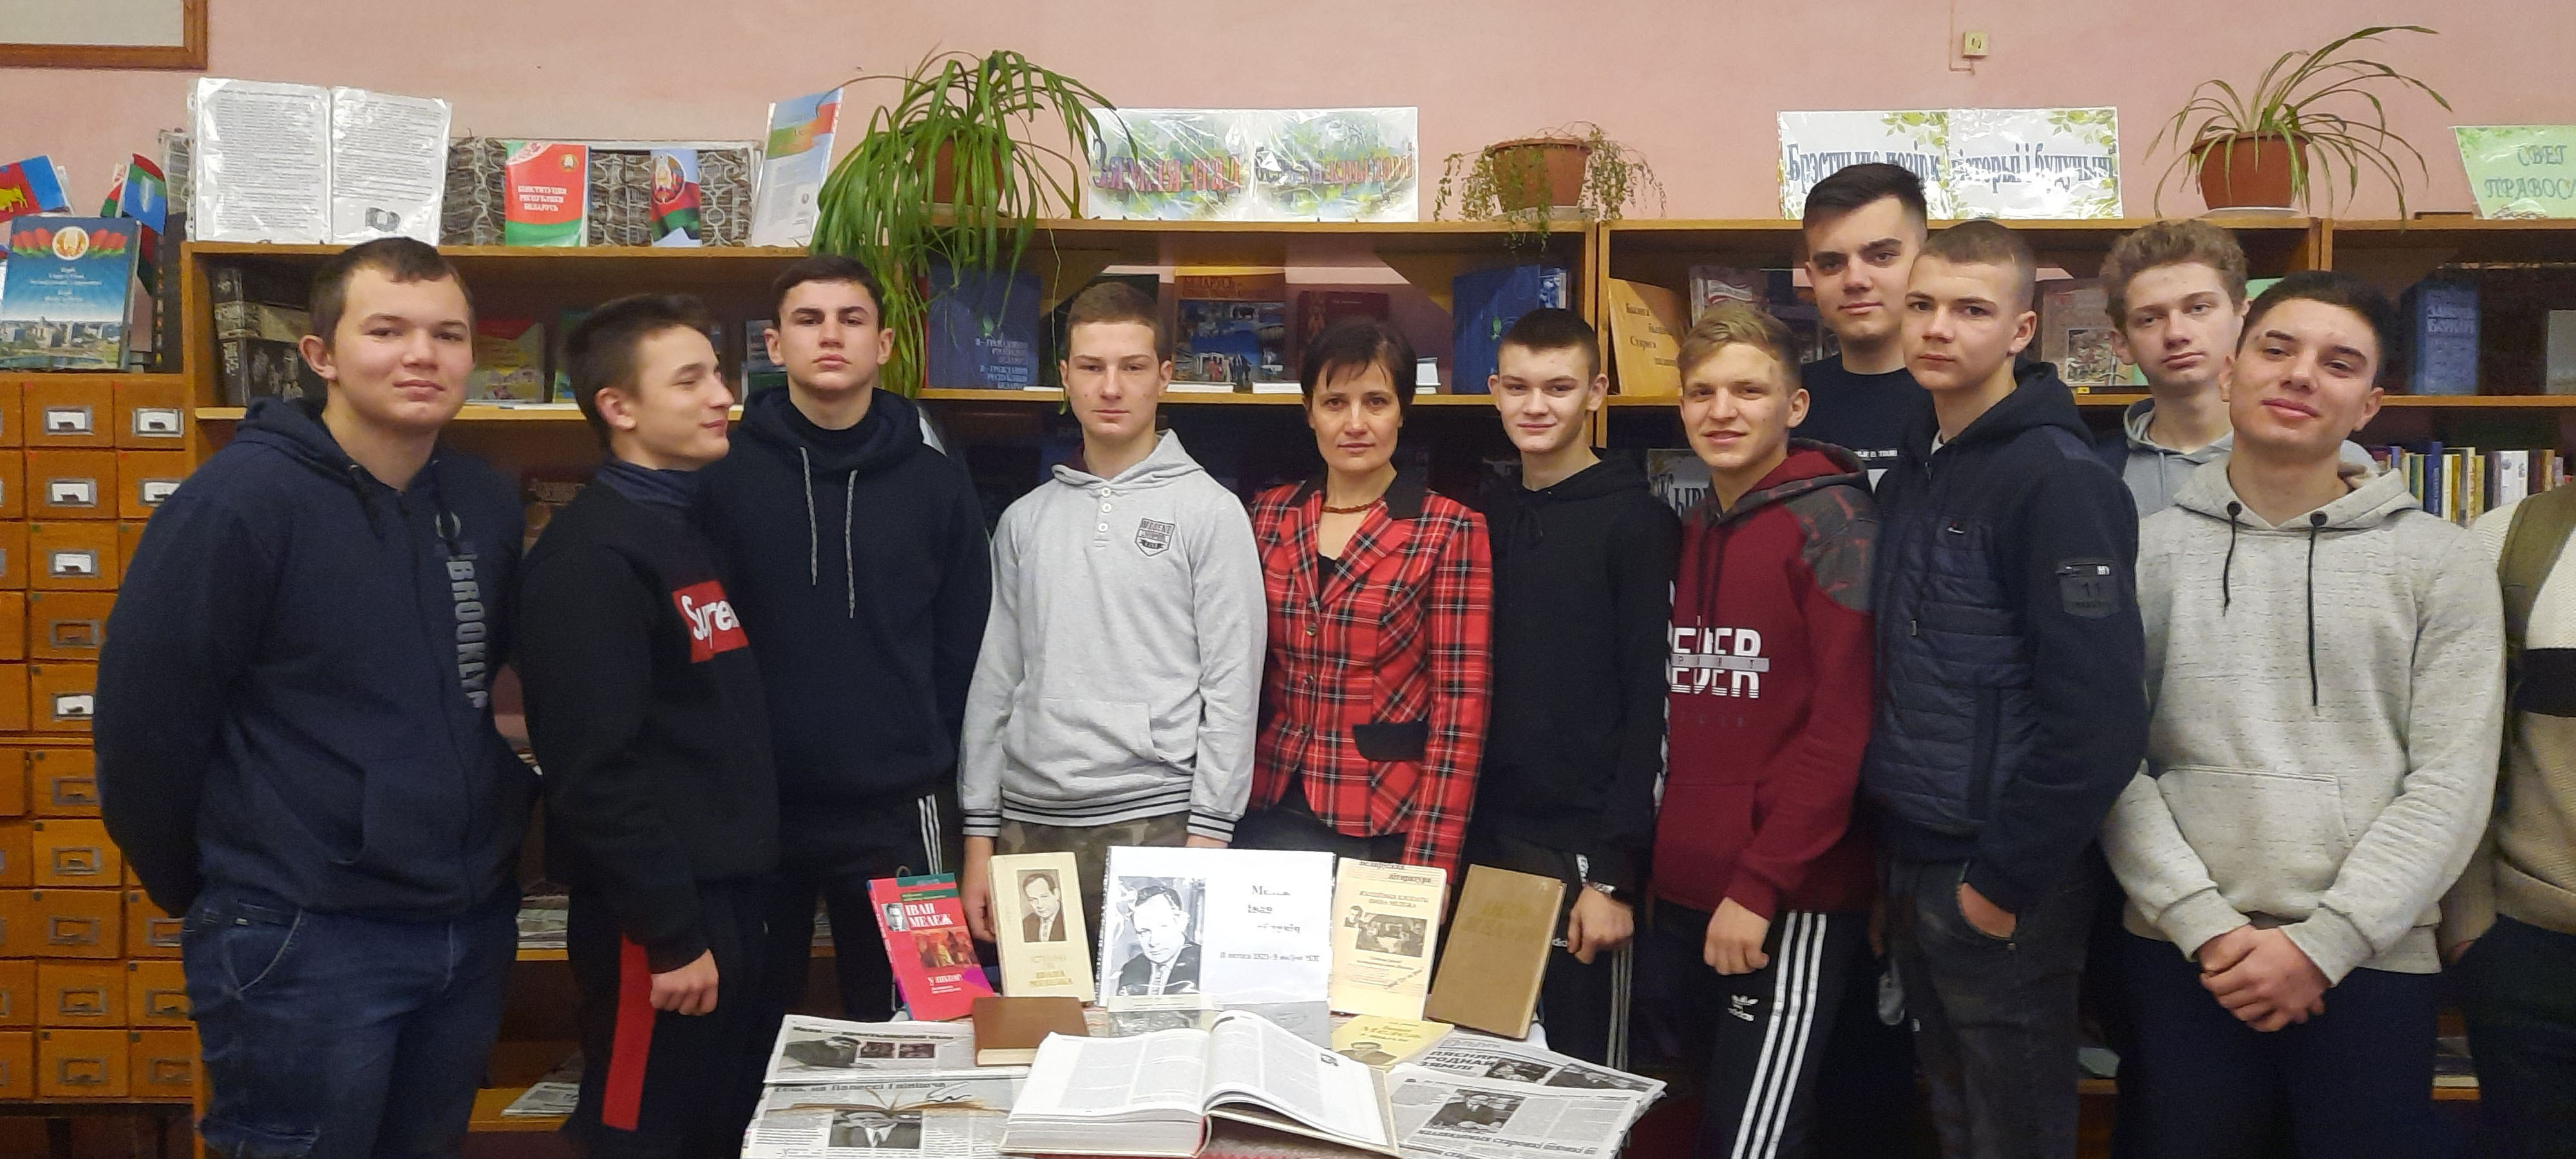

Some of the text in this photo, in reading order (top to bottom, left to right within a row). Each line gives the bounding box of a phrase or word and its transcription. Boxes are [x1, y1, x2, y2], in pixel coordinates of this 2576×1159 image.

[2518, 145, 2567, 166] СВЕТ
[904, 903, 935, 916] ІВАН
[908, 914, 953, 927] МЕЛЕЖ
[1727, 1007, 1755, 1022] adidas
[1429, 1050, 1500, 1060] ПЯСНЯР
[1417, 1061, 1473, 1071] ЗЯМЛІ
